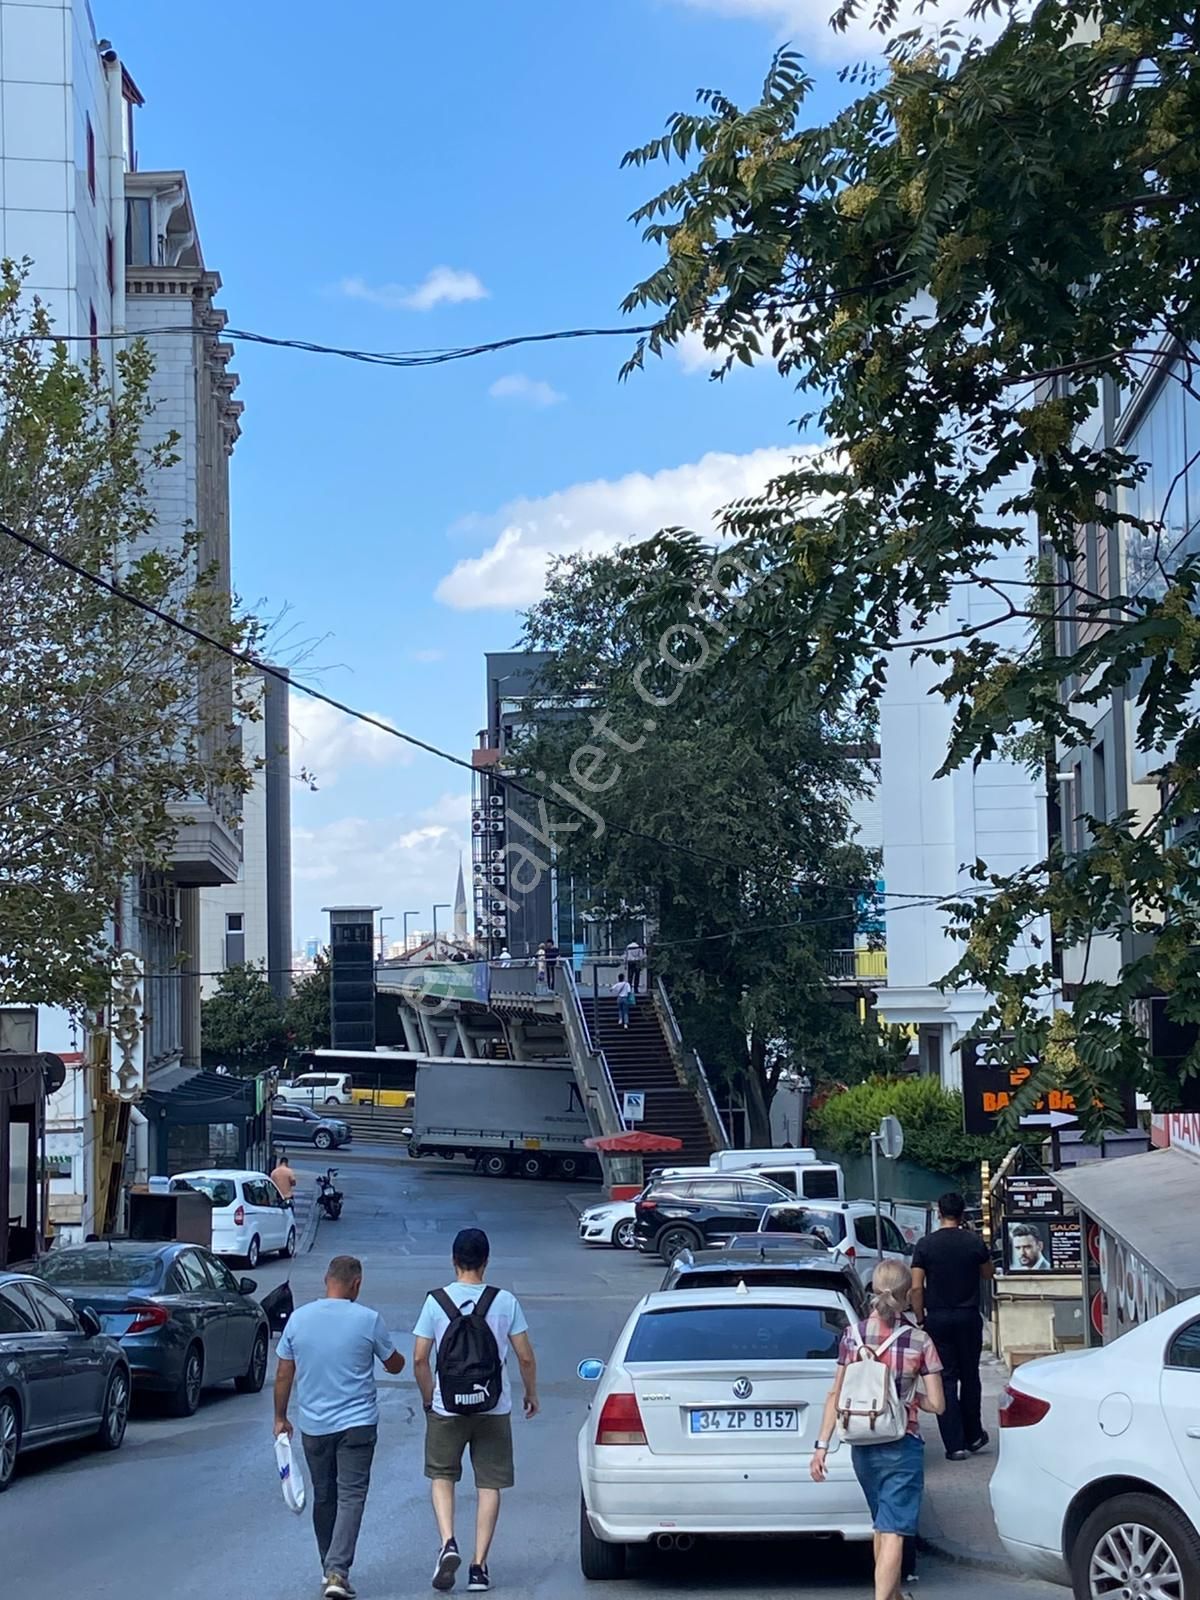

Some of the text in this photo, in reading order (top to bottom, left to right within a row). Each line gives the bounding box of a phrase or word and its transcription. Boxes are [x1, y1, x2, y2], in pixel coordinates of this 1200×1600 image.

[454, 1391, 486, 1406] PUMA
[699, 1410, 795, 1430] 34 ZP 8157
